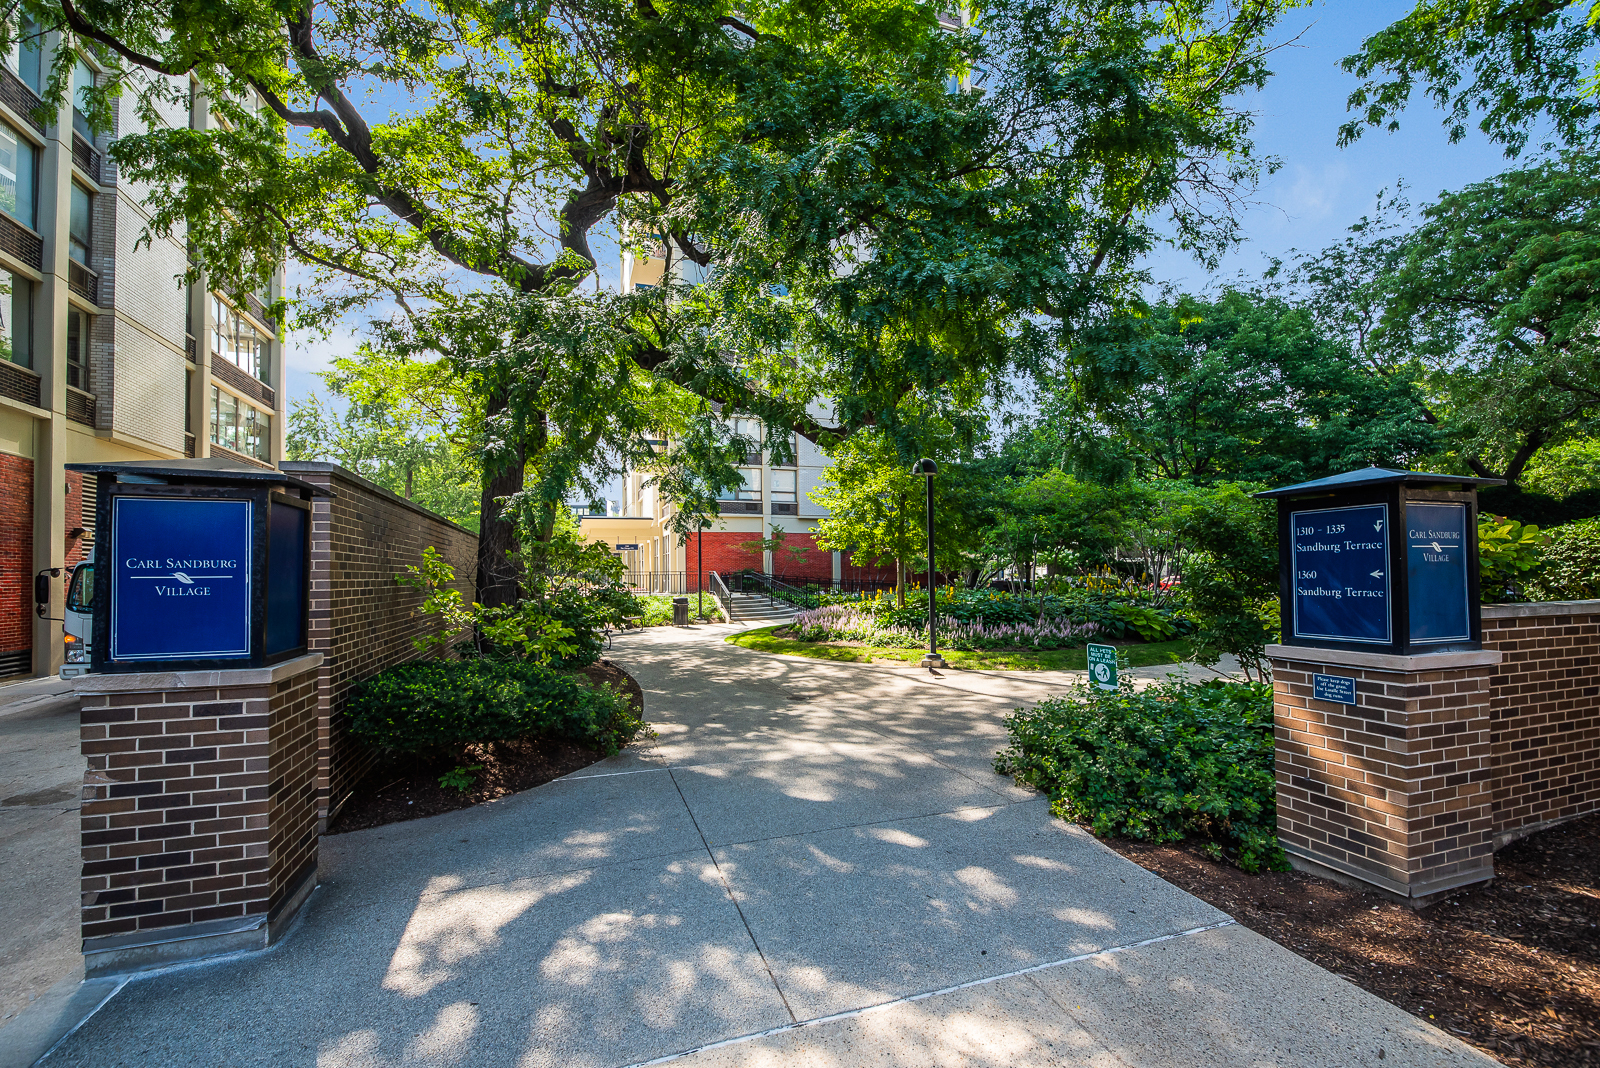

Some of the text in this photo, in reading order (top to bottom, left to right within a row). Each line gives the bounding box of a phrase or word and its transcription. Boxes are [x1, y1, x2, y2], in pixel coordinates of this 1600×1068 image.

[1296, 526, 1314, 536] 1310
[1326, 524, 1346, 534] 1335
[1409, 529, 1460, 539] CARL SANDBURG
[1296, 540, 1383, 553] Sandburg Terrace
[1423, 552, 1449, 562] VILLAGE
[126, 558, 237, 569] CARL SANDBURG
[1298, 570, 1317, 580] 1360
[155, 586, 211, 596] VILLAGE
[1298, 586, 1384, 599] Sandburg Terrace
